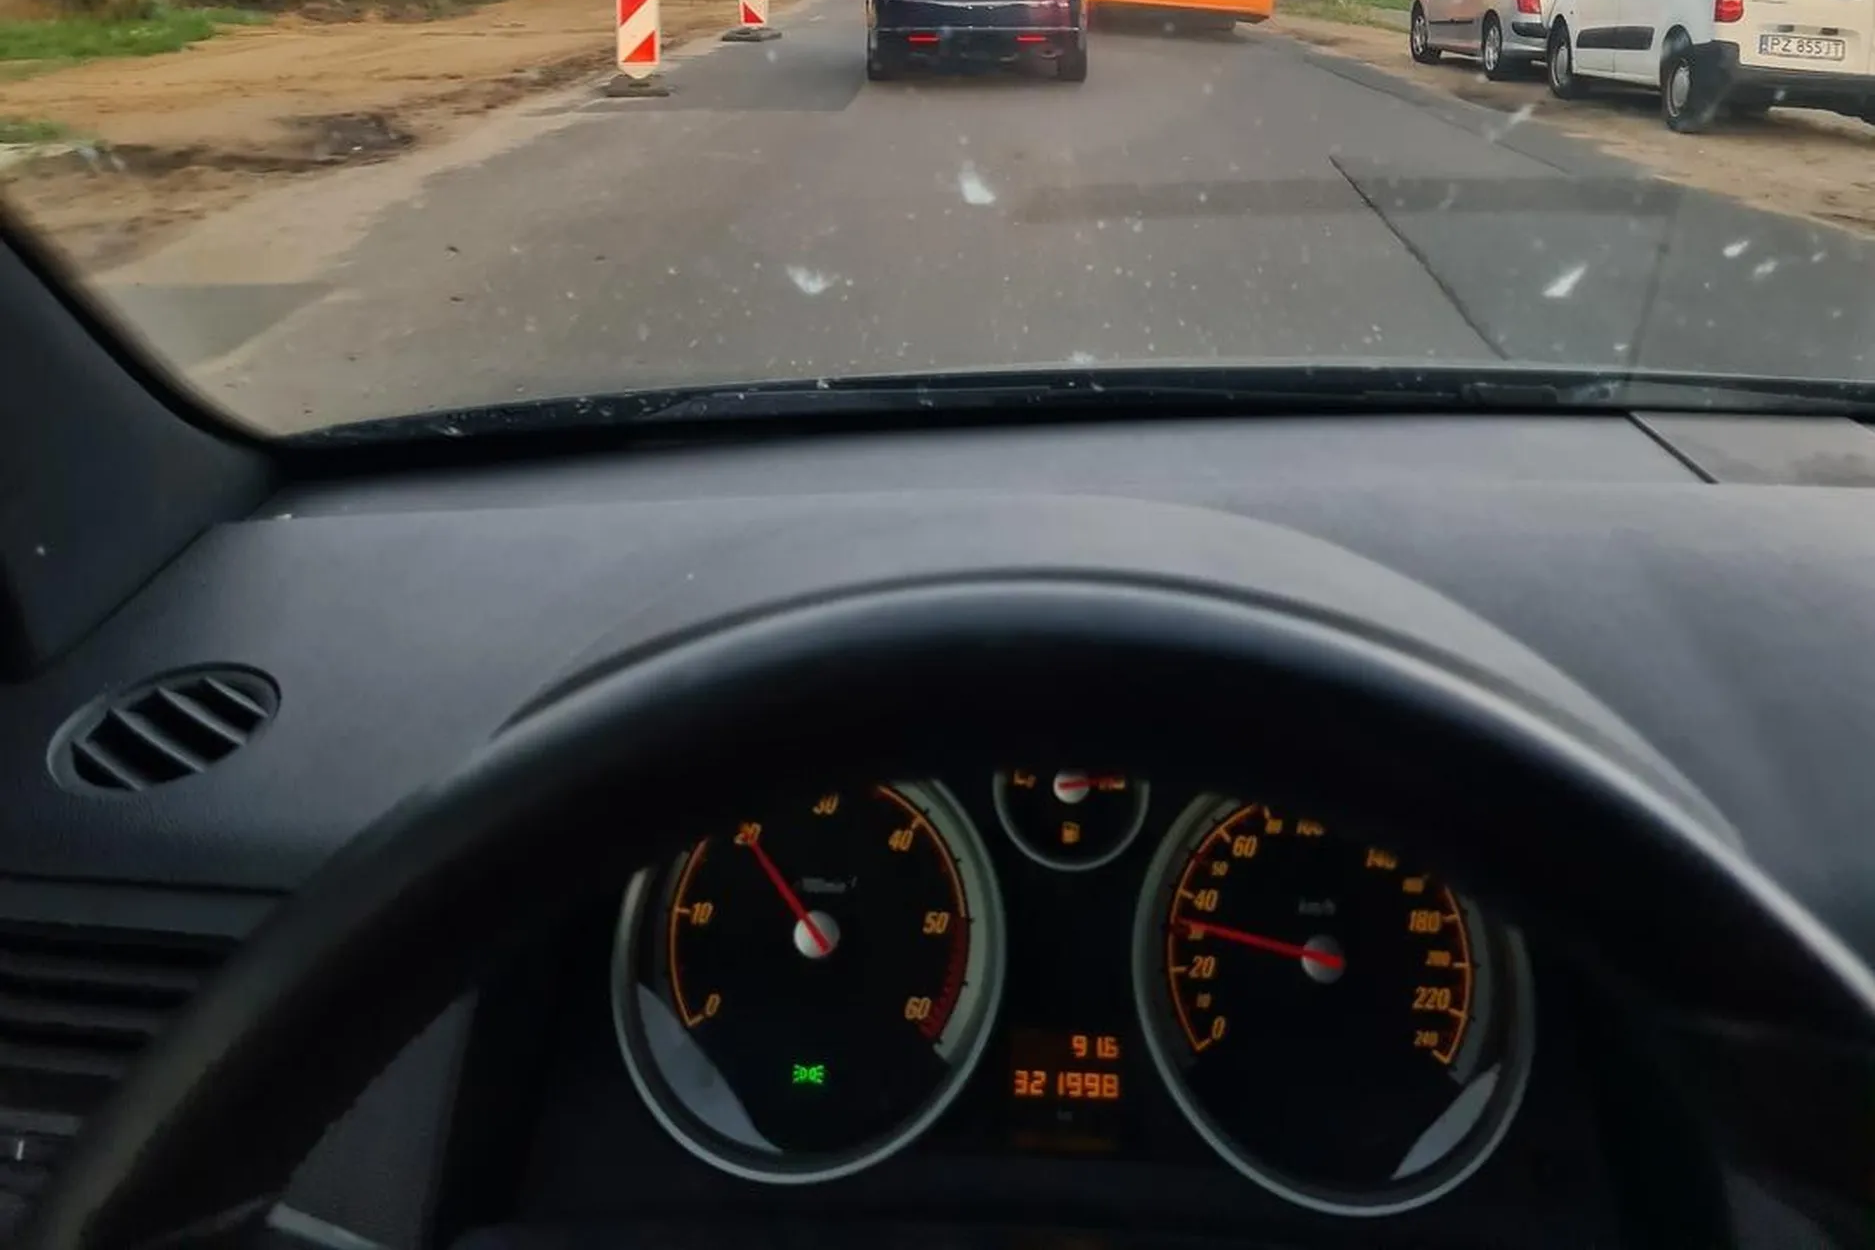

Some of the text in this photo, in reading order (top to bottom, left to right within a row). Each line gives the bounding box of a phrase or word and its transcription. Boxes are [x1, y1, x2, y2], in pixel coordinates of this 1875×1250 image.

[1770, 37, 1792, 52] PZ
[888, 829, 914, 851] 40
[1232, 836, 1258, 858] 60
[1193, 889, 1218, 911] 40
[690, 902, 714, 925] 10
[923, 912, 950, 934] 50
[1409, 910, 1441, 933] 180
[1188, 956, 1215, 978] 20
[706, 994, 721, 1016] 0
[904, 996, 932, 1020] 60
[1412, 986, 1451, 1010] 220
[1212, 1016, 1226, 1040] 0
